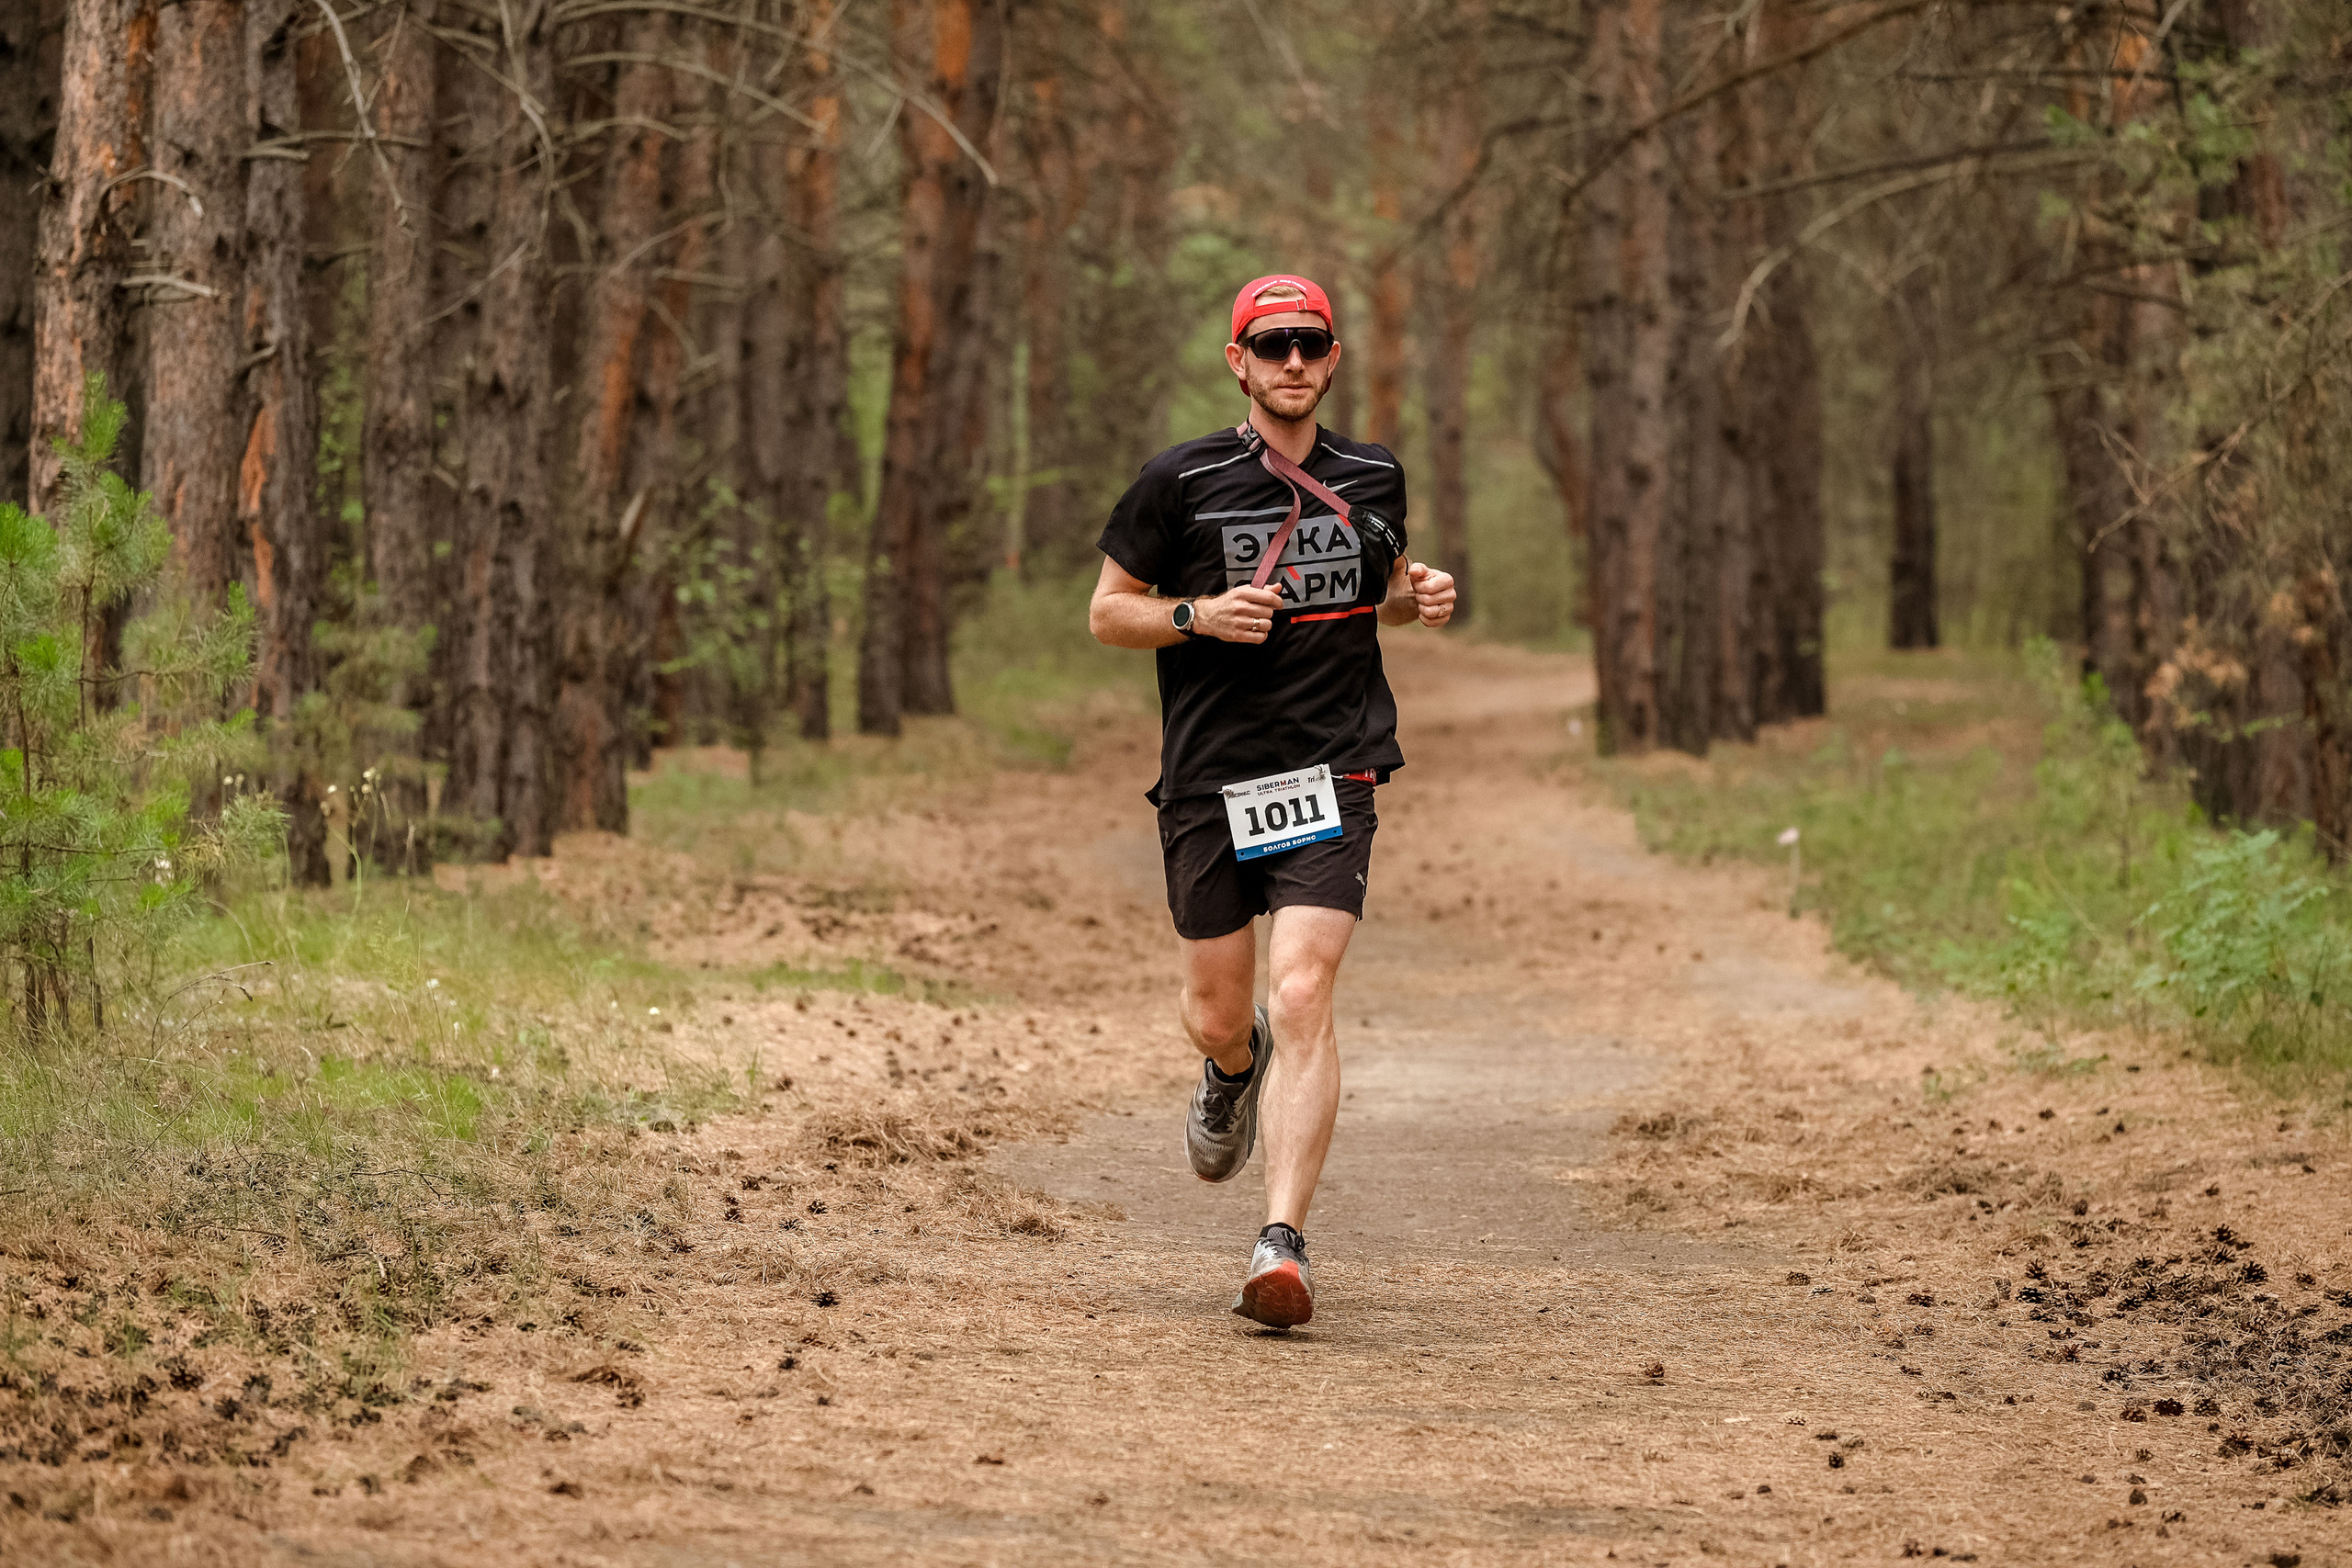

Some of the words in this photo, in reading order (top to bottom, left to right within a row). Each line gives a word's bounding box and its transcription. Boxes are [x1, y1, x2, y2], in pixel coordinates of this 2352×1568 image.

[1234, 568, 1357, 604] АРМ
[1256, 778, 1300, 791] SIBERMAN
[1274, 784, 1300, 792] TRIATHLON
[1244, 794, 1326, 837] 1011
[1263, 841, 1291, 852] БОЛГОВ
[1292, 834, 1317, 845] БОРИС
